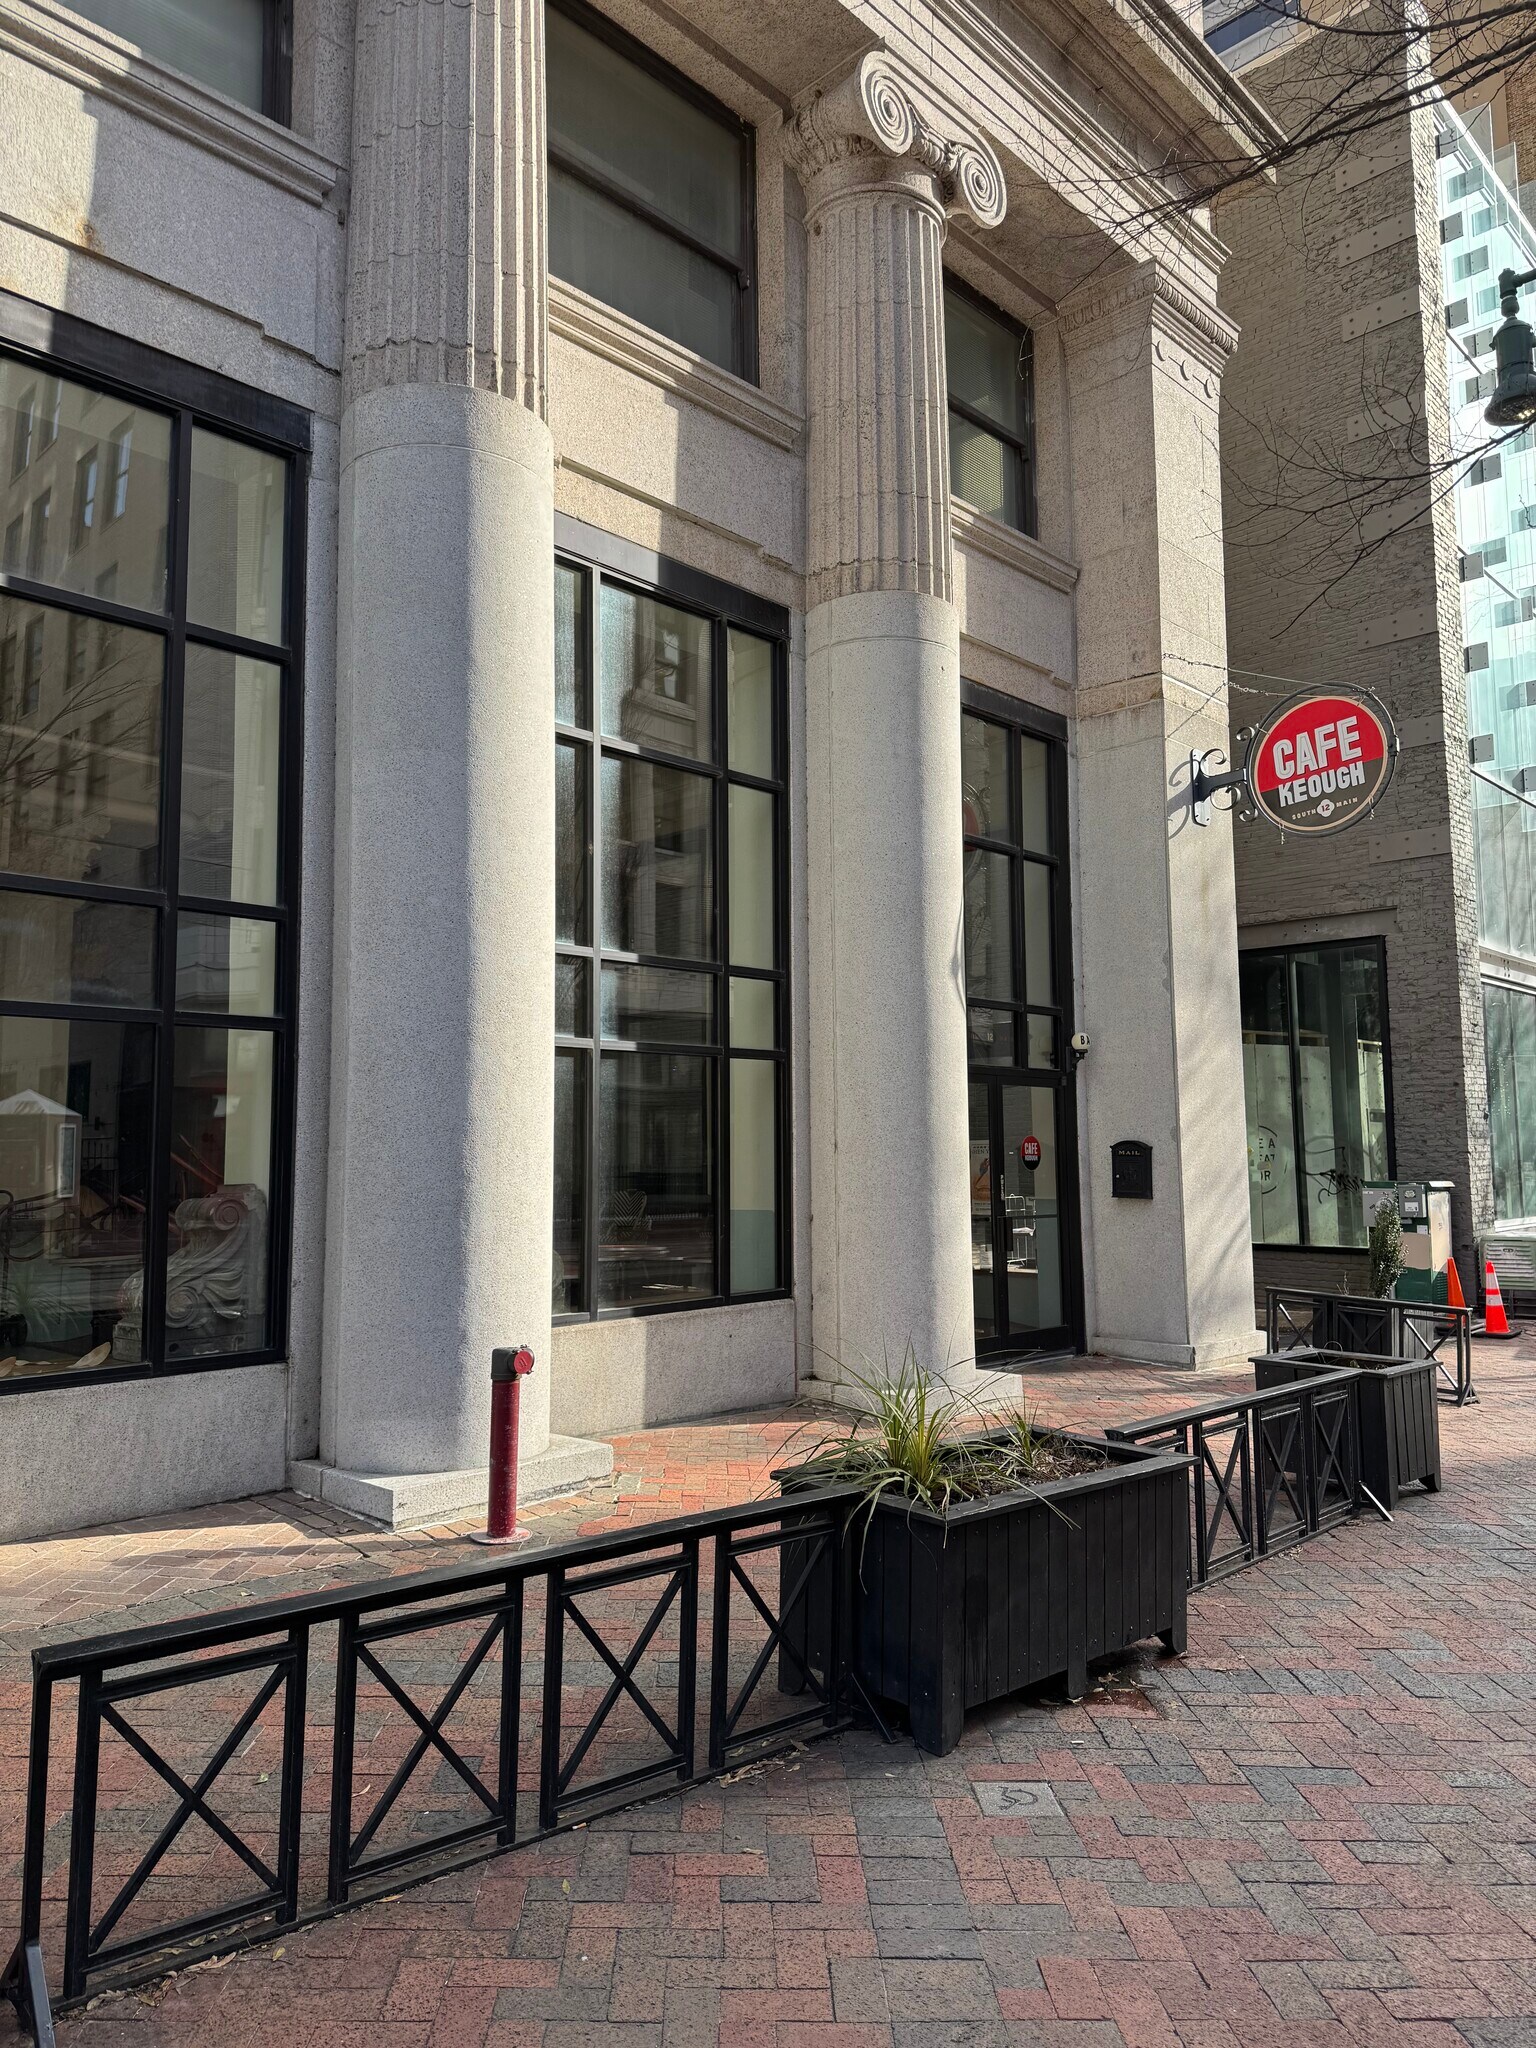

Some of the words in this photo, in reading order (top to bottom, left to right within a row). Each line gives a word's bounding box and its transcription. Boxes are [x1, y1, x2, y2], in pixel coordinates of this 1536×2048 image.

[1272, 715, 1363, 780] CAFE
[1278, 761, 1366, 808] KEOUGH
[1291, 808, 1317, 820] SOUTH
[1321, 803, 1331, 812] 12
[1336, 797, 1358, 808] MAIN
[986, 1032, 994, 1041] 12
[1024, 1142, 1038, 1155] CAFE
